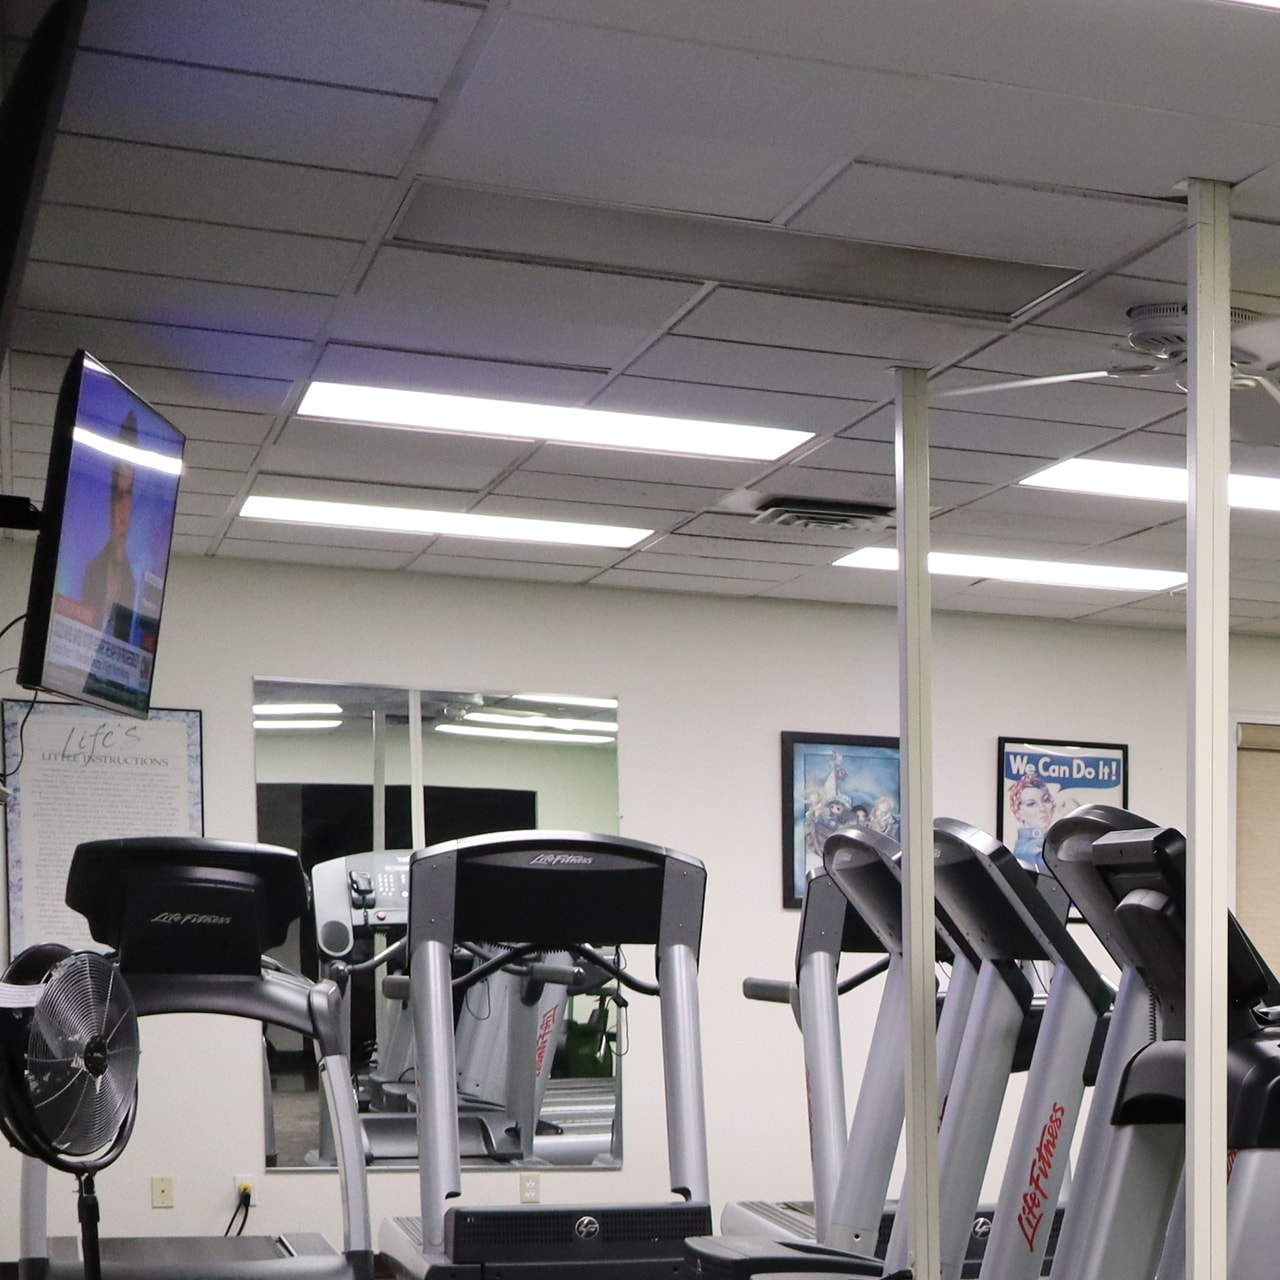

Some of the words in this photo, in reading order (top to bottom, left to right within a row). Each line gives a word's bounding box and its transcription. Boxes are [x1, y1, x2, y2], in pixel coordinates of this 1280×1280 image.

[41, 751, 79, 763] LITTLE
[83, 755, 170, 767] INSTRUCTIONS
[61, 722, 143, 769] Life's
[1009, 754, 1036, 776] We
[1038, 756, 1069, 778] Can
[1072, 759, 1096, 780] Do
[1098, 760, 1117, 781] It!
